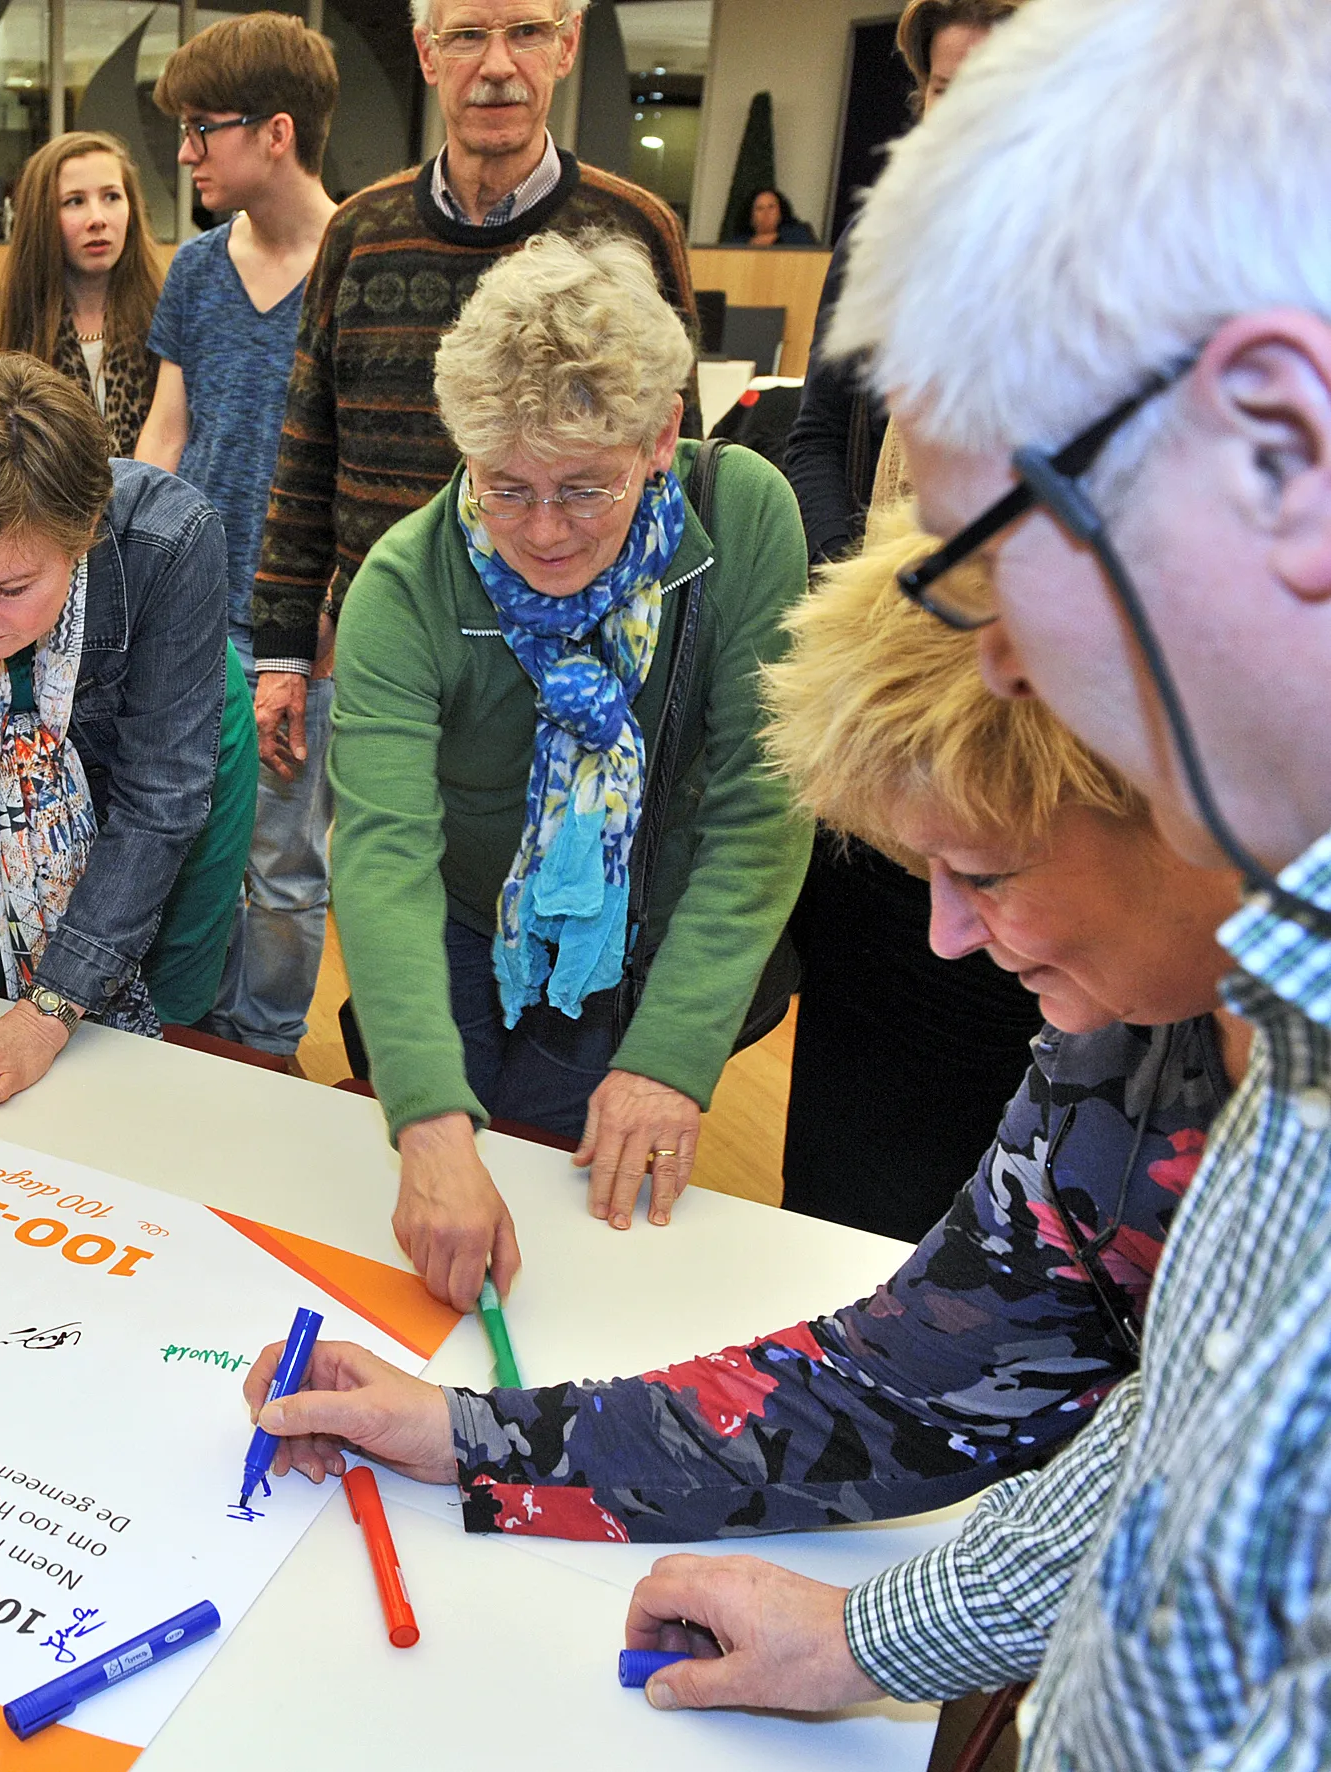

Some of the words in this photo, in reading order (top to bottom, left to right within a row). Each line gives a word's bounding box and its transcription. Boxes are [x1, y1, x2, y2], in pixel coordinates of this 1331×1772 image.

[56, 1195, 115, 1219] 100
[18, 1511, 63, 1536] 100
[96, 1509, 132, 1533] De
[66, 1531, 108, 1557] om
[8, 1545, 83, 1591] Noem
